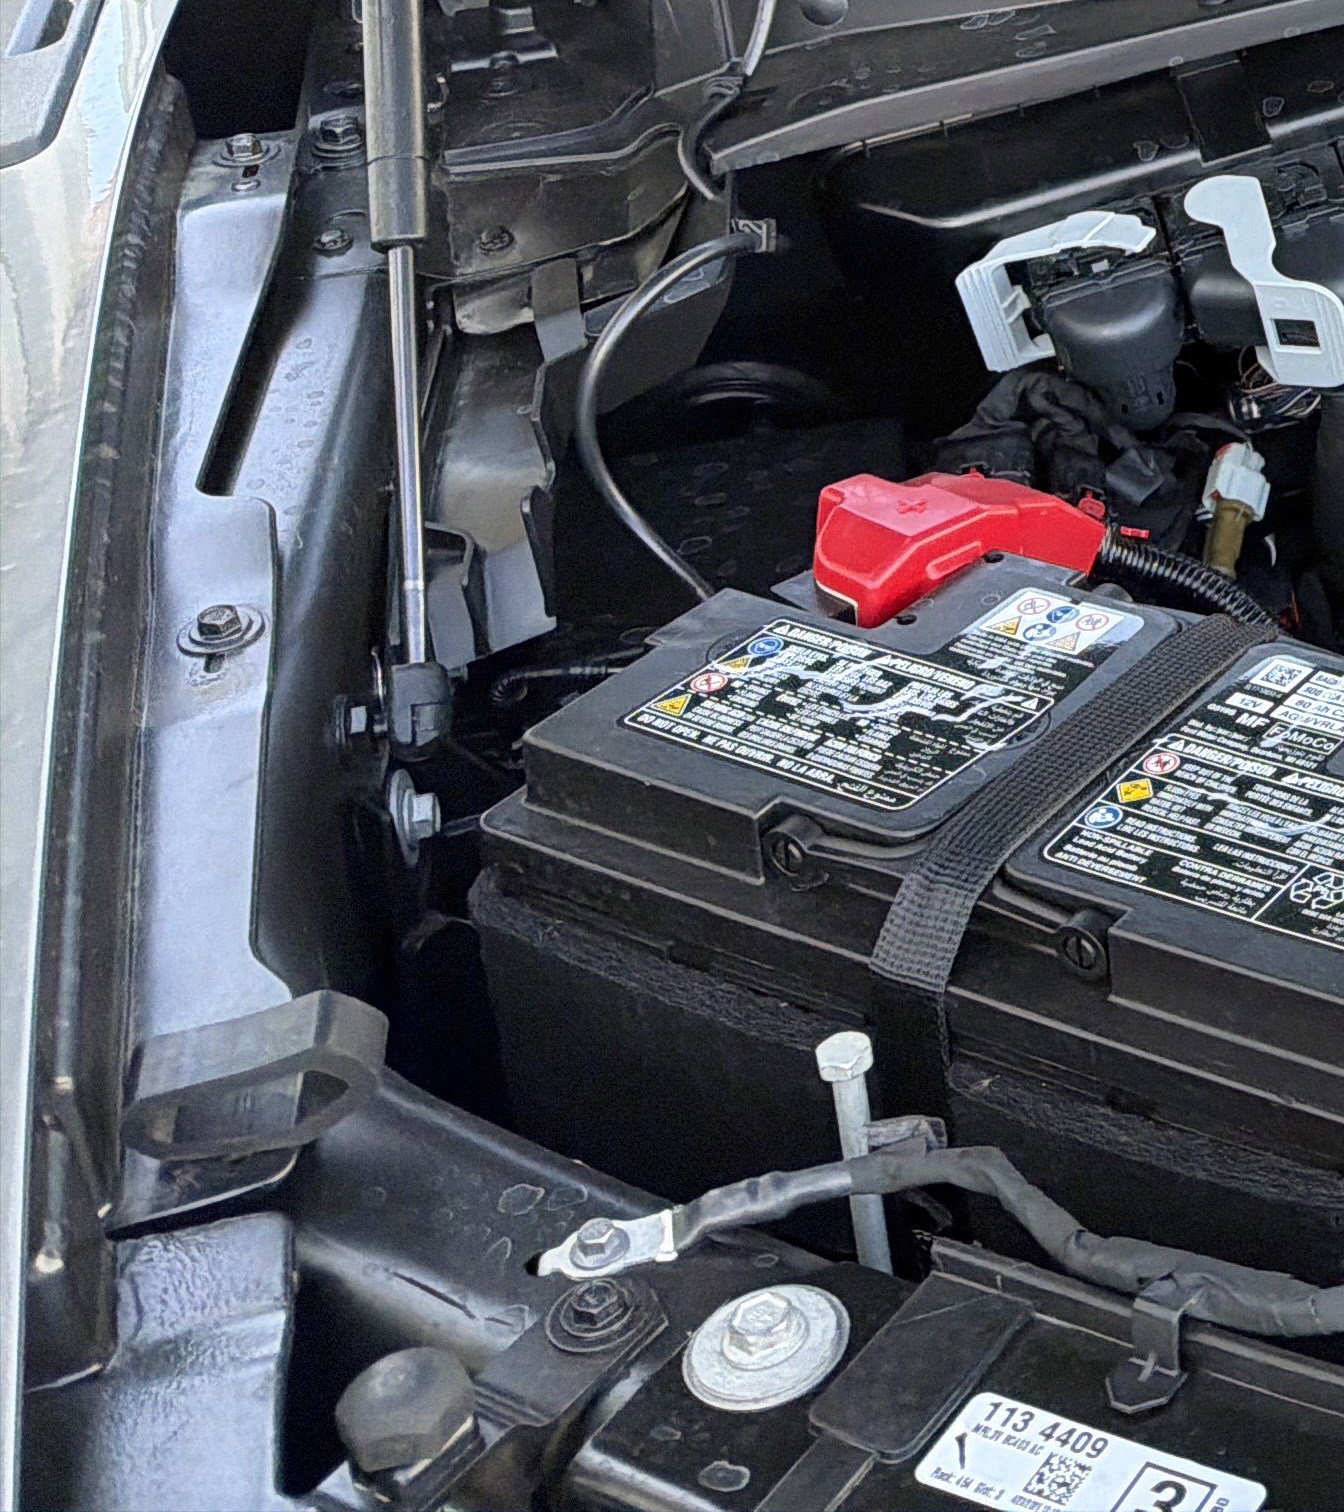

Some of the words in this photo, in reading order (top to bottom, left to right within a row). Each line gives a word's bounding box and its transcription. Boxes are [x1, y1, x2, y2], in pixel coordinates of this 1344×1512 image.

[1236, 696, 1264, 709] 12V
[1232, 712, 1272, 730] MF
[984, 1401, 1035, 1433] 113
[1038, 1421, 1109, 1459] 4409
